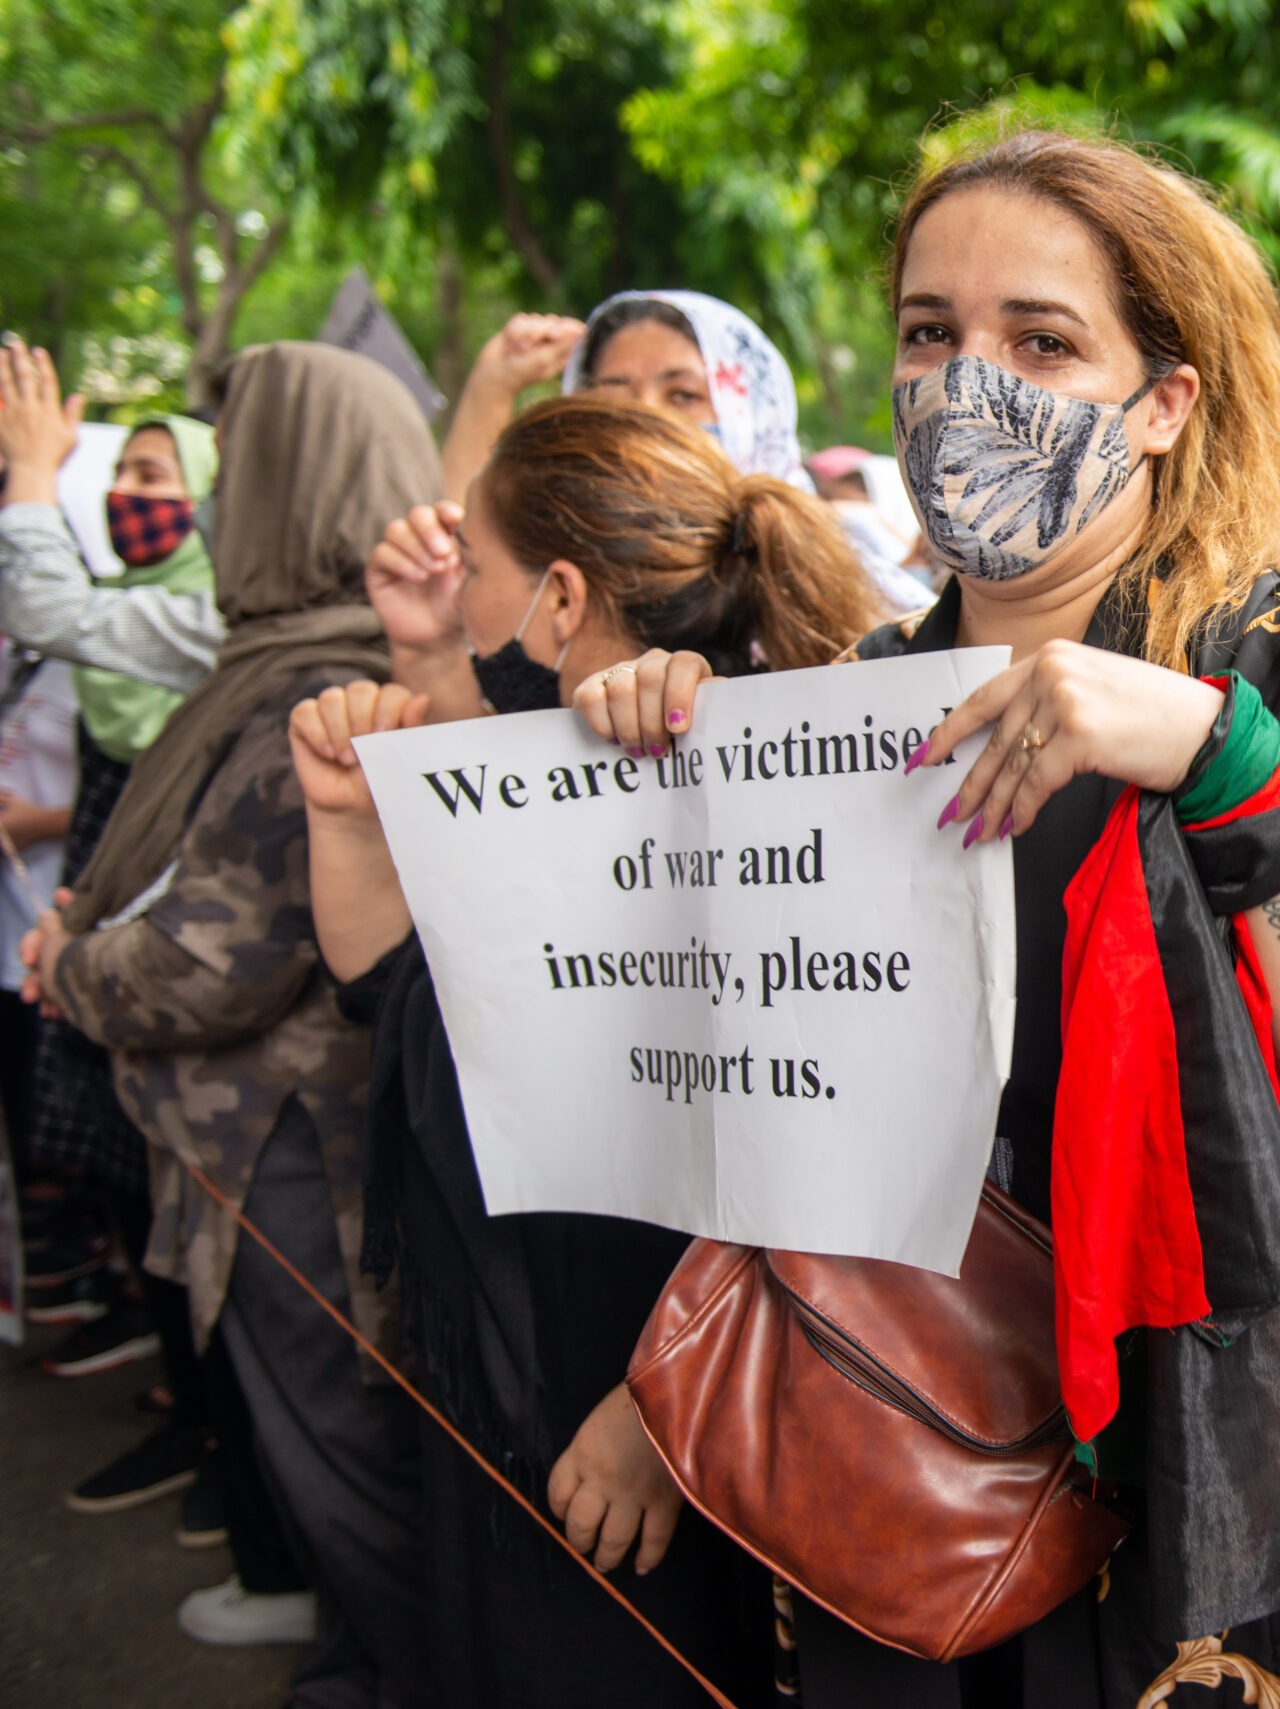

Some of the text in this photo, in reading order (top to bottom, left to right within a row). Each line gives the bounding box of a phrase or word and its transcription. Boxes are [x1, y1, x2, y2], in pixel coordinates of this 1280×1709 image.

[421, 764, 528, 818] We
[546, 756, 641, 802] are
[655, 734, 704, 790] the
[612, 828, 826, 891] of war and
[543, 935, 911, 1008] insecurity, please
[629, 1045, 837, 1106] support us.
